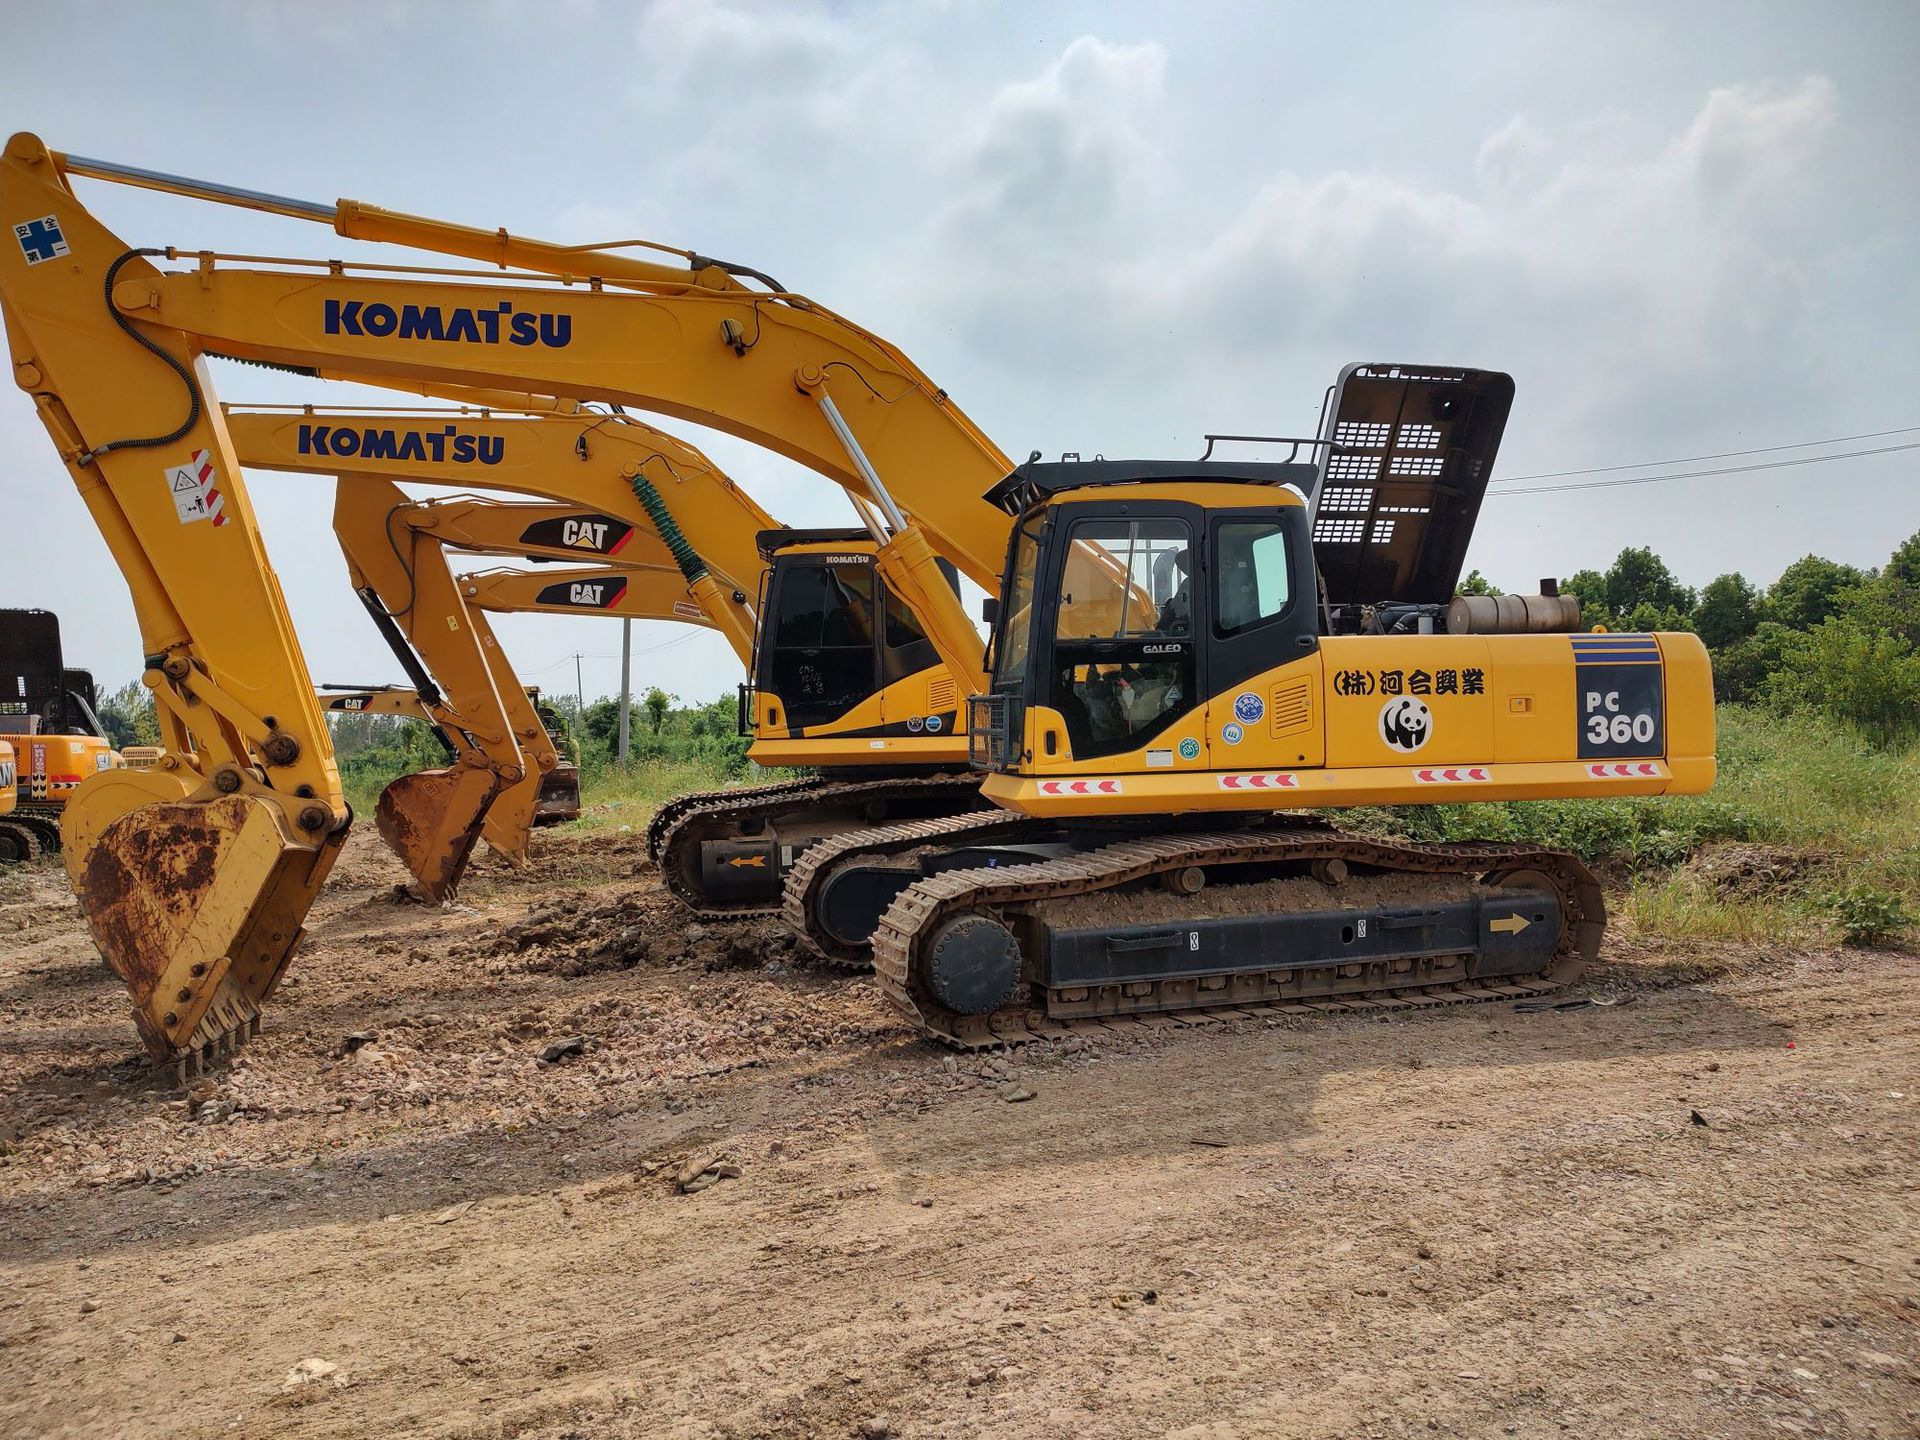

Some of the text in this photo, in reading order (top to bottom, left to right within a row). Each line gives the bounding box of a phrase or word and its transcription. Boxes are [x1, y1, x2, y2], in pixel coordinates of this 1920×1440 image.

[324, 299, 573, 348] KOMATSU
[298, 424, 505, 465] KOMATSU
[562, 519, 609, 549] CAT
[826, 554, 870, 564] KOMATSU
[570, 583, 604, 605] CAT
[1142, 643, 1182, 654] GALEO
[344, 698, 363, 710] CAT
[1586, 691, 1620, 713] PC
[1587, 714, 1655, 745] 360
